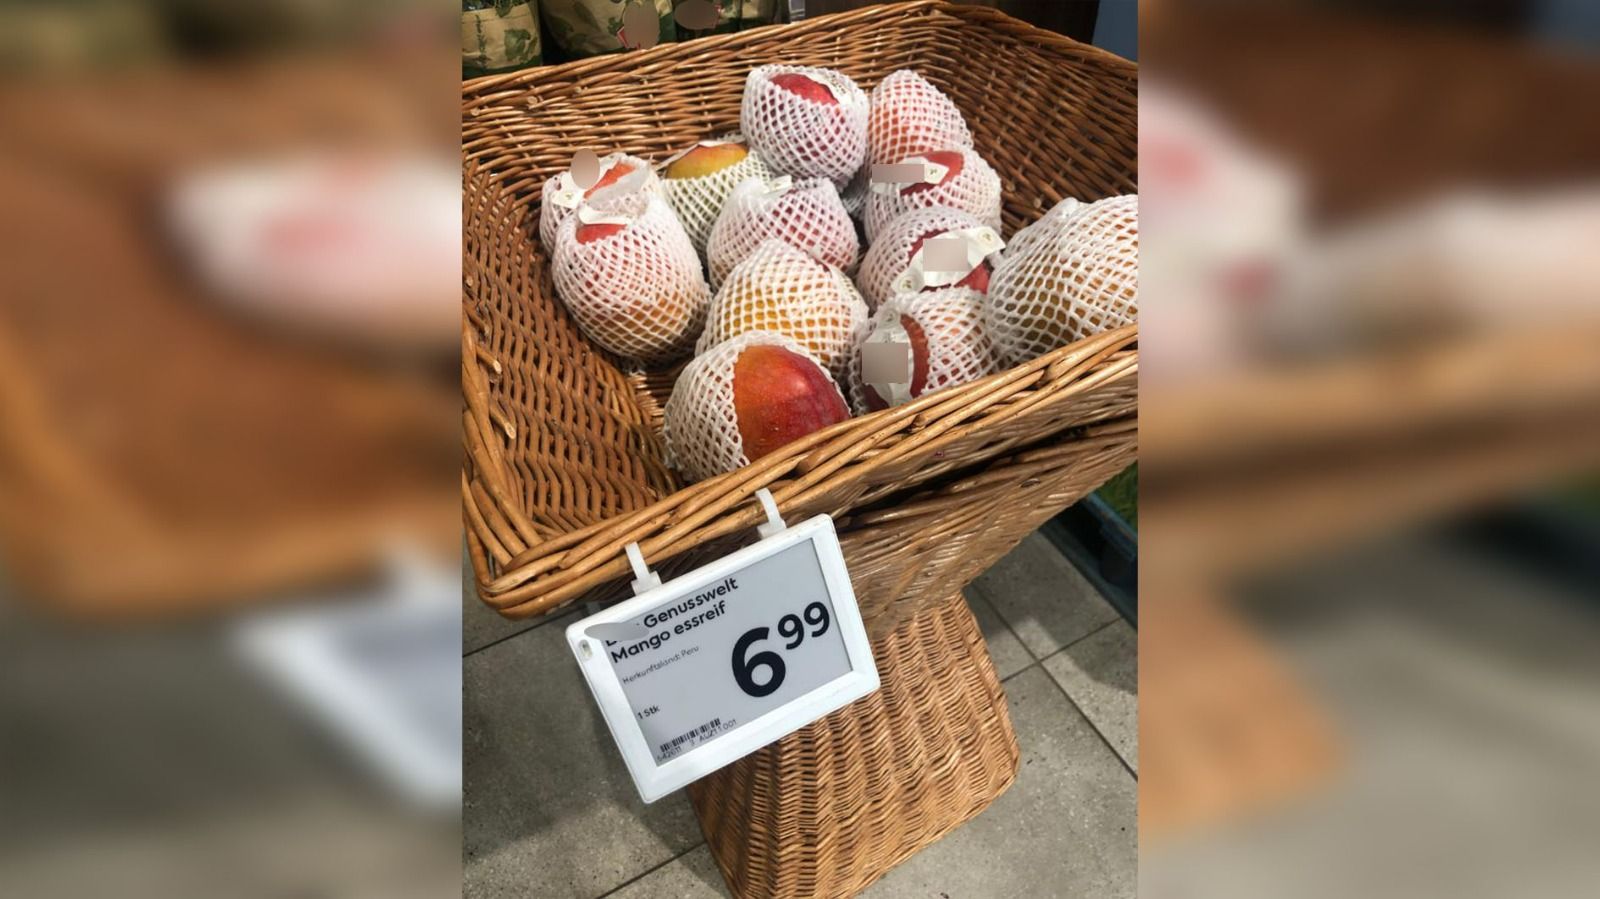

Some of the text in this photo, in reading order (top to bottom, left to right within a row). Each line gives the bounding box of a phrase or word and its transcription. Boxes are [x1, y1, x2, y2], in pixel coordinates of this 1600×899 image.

[643, 577, 739, 628] Genusswelt
[610, 630, 671, 664] Mango
[673, 600, 726, 635] essreif
[622, 646, 700, 684] Herkunftsland: Peru
[637, 704, 661, 720] 1 Stk
